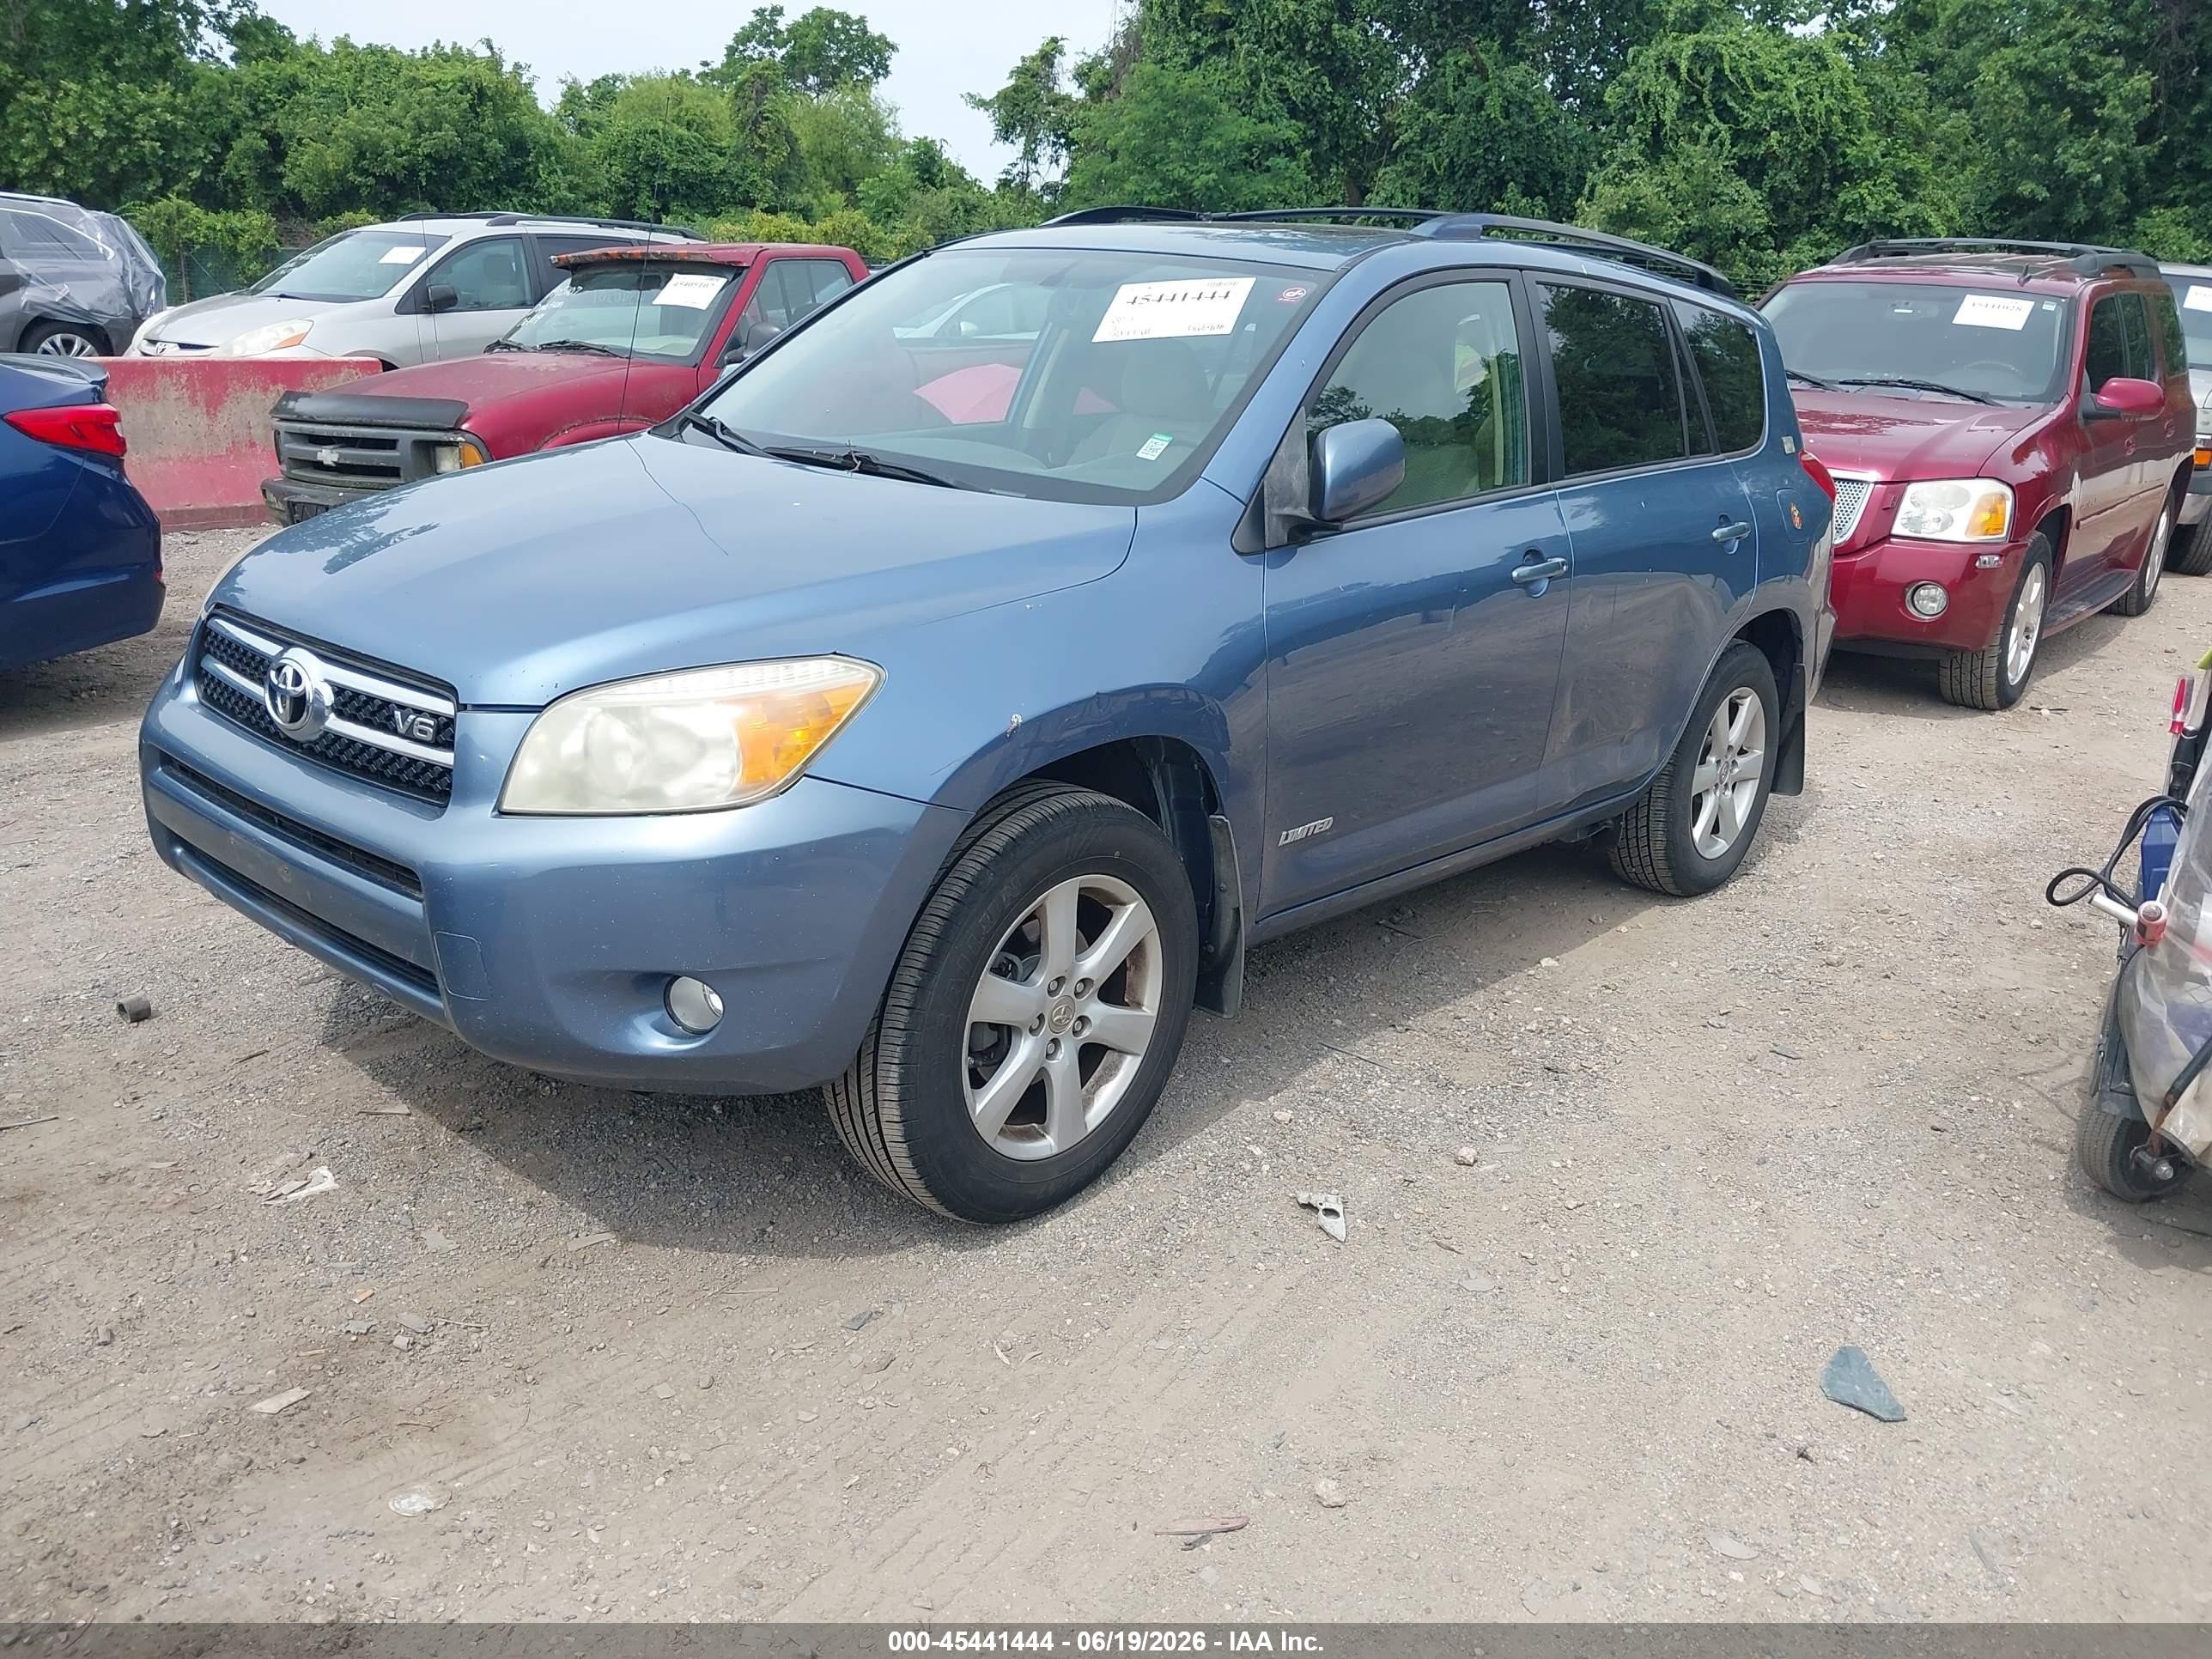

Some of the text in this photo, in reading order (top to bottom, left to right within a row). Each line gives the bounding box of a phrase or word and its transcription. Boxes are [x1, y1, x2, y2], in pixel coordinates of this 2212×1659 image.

[1126, 290, 1231, 306] 45441444
[393, 710, 435, 744] V6
[1278, 817, 1334, 847] LIMITED
